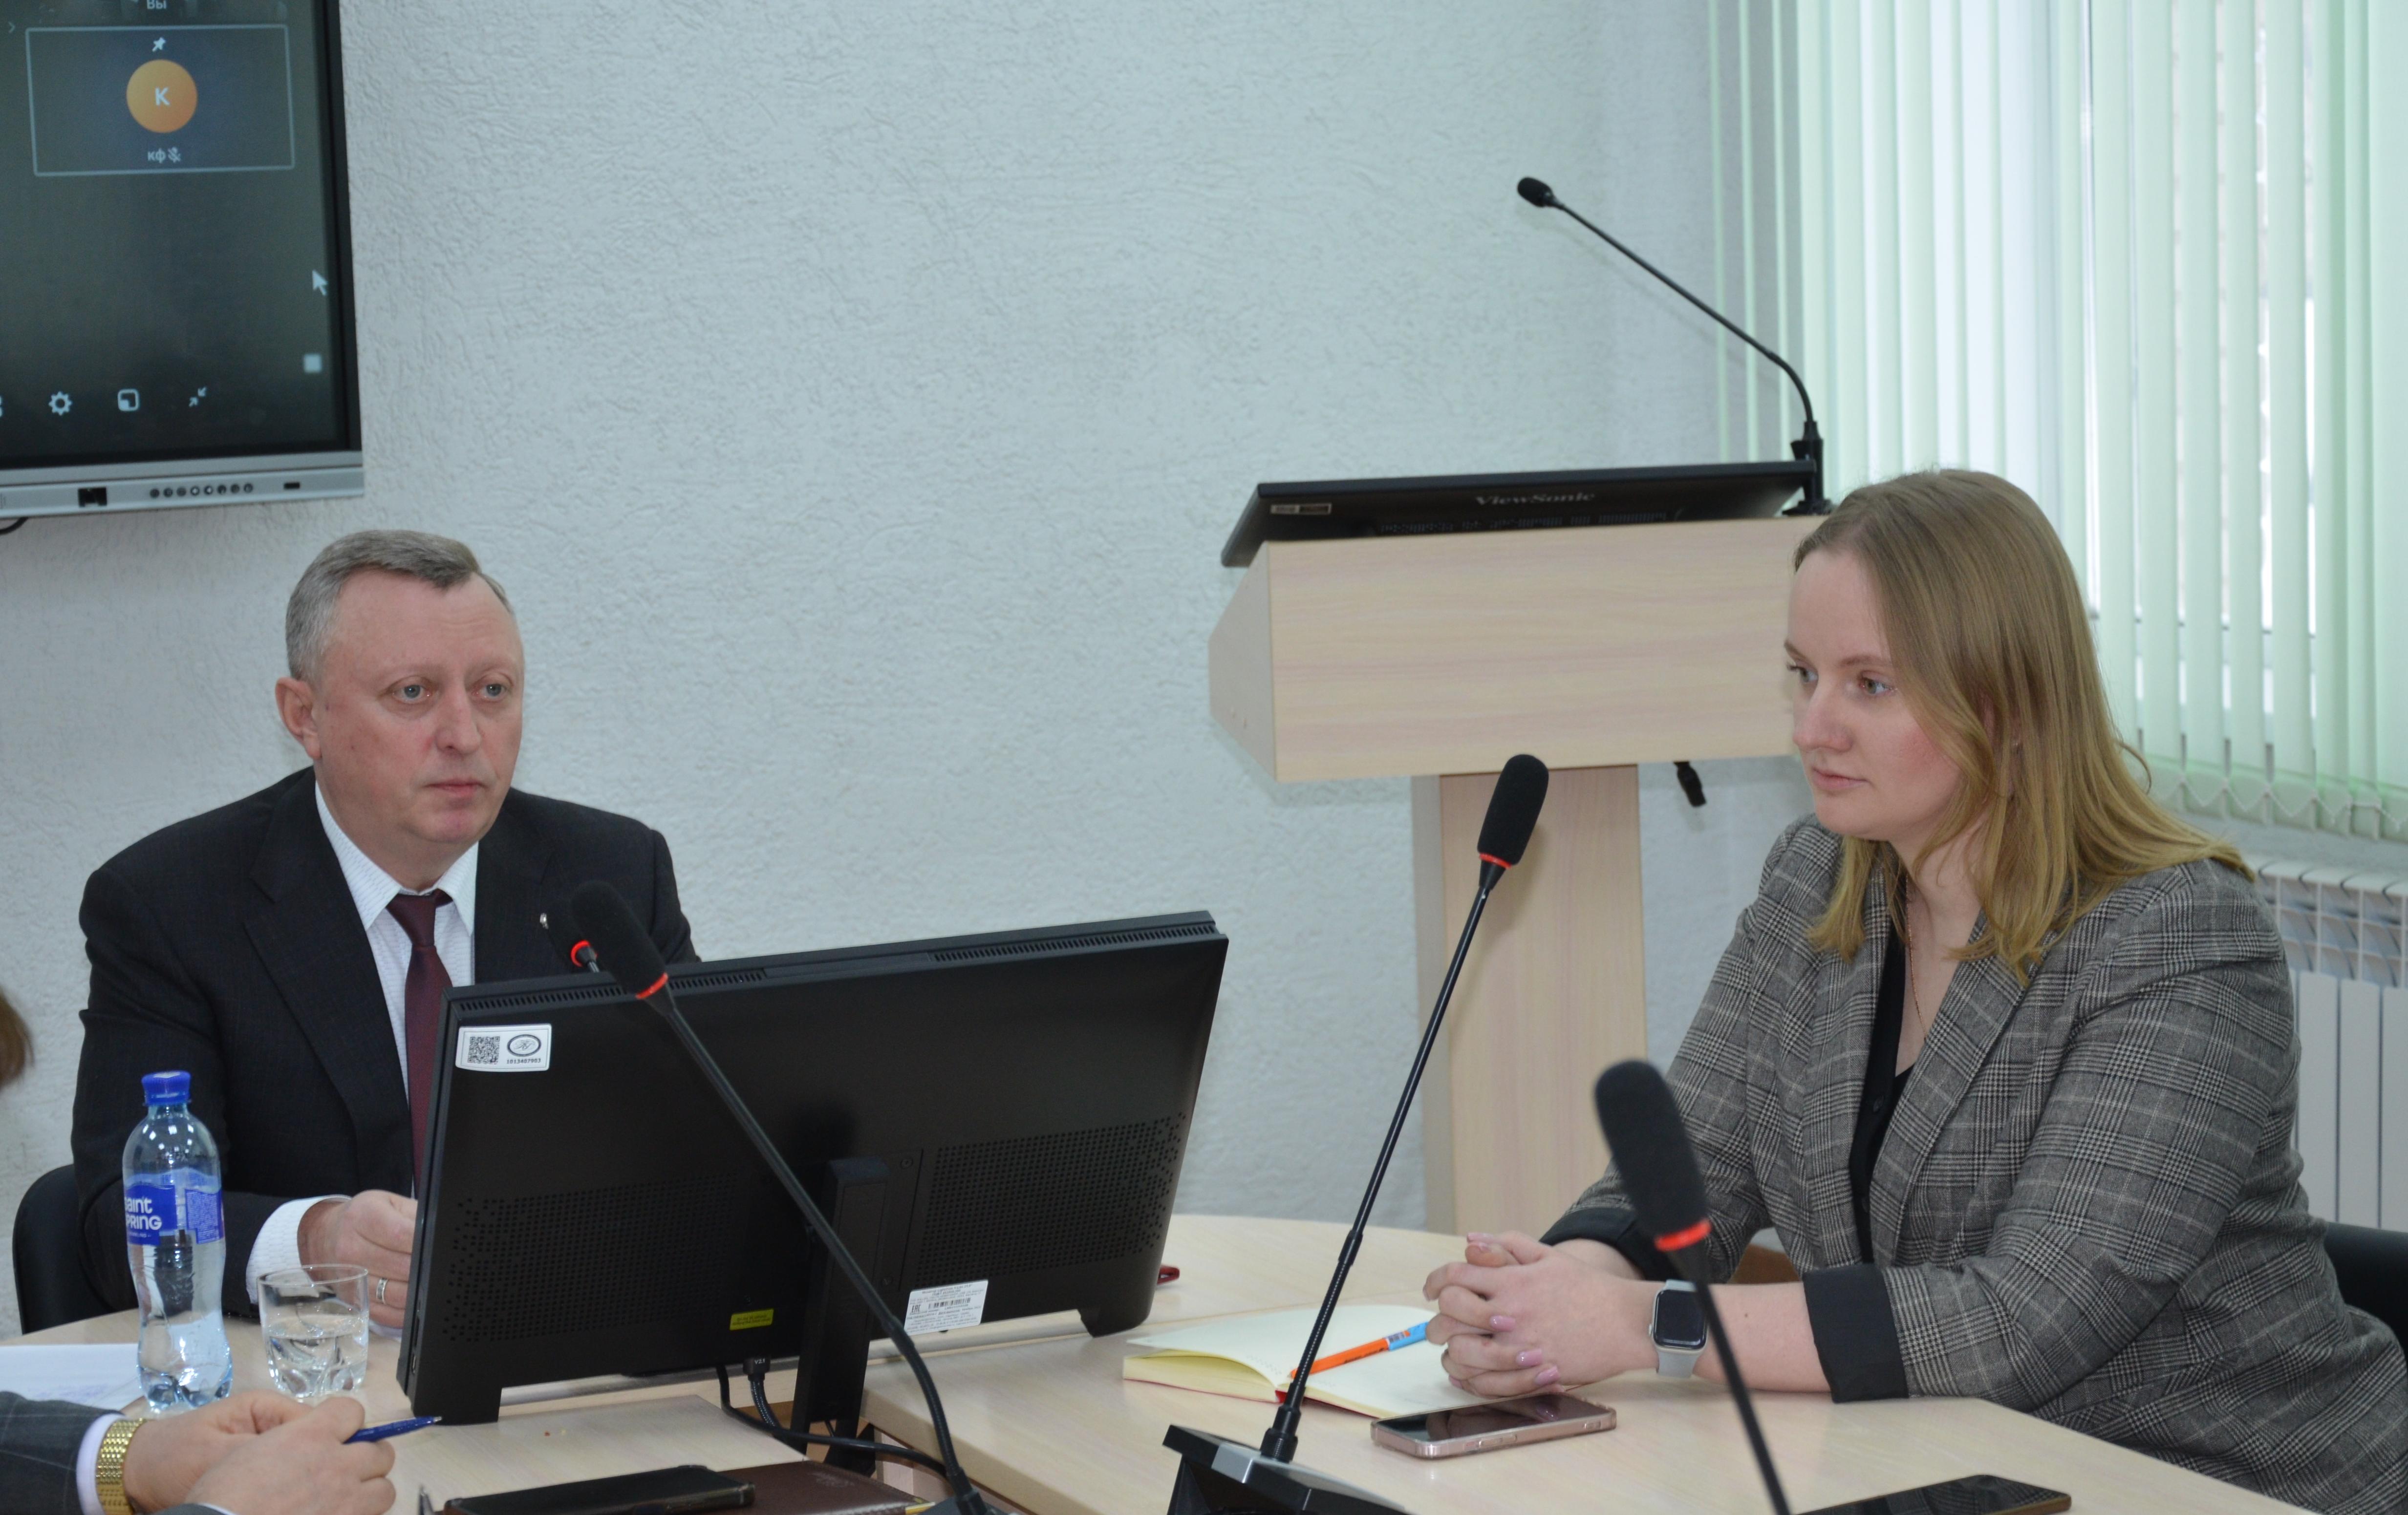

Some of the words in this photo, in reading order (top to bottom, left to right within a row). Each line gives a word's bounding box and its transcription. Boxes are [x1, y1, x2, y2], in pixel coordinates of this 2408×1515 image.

[148, 148, 167, 164] кф
[1476, 492, 1596, 505] ViewSonic
[126, 1214, 162, 1230] PRING
